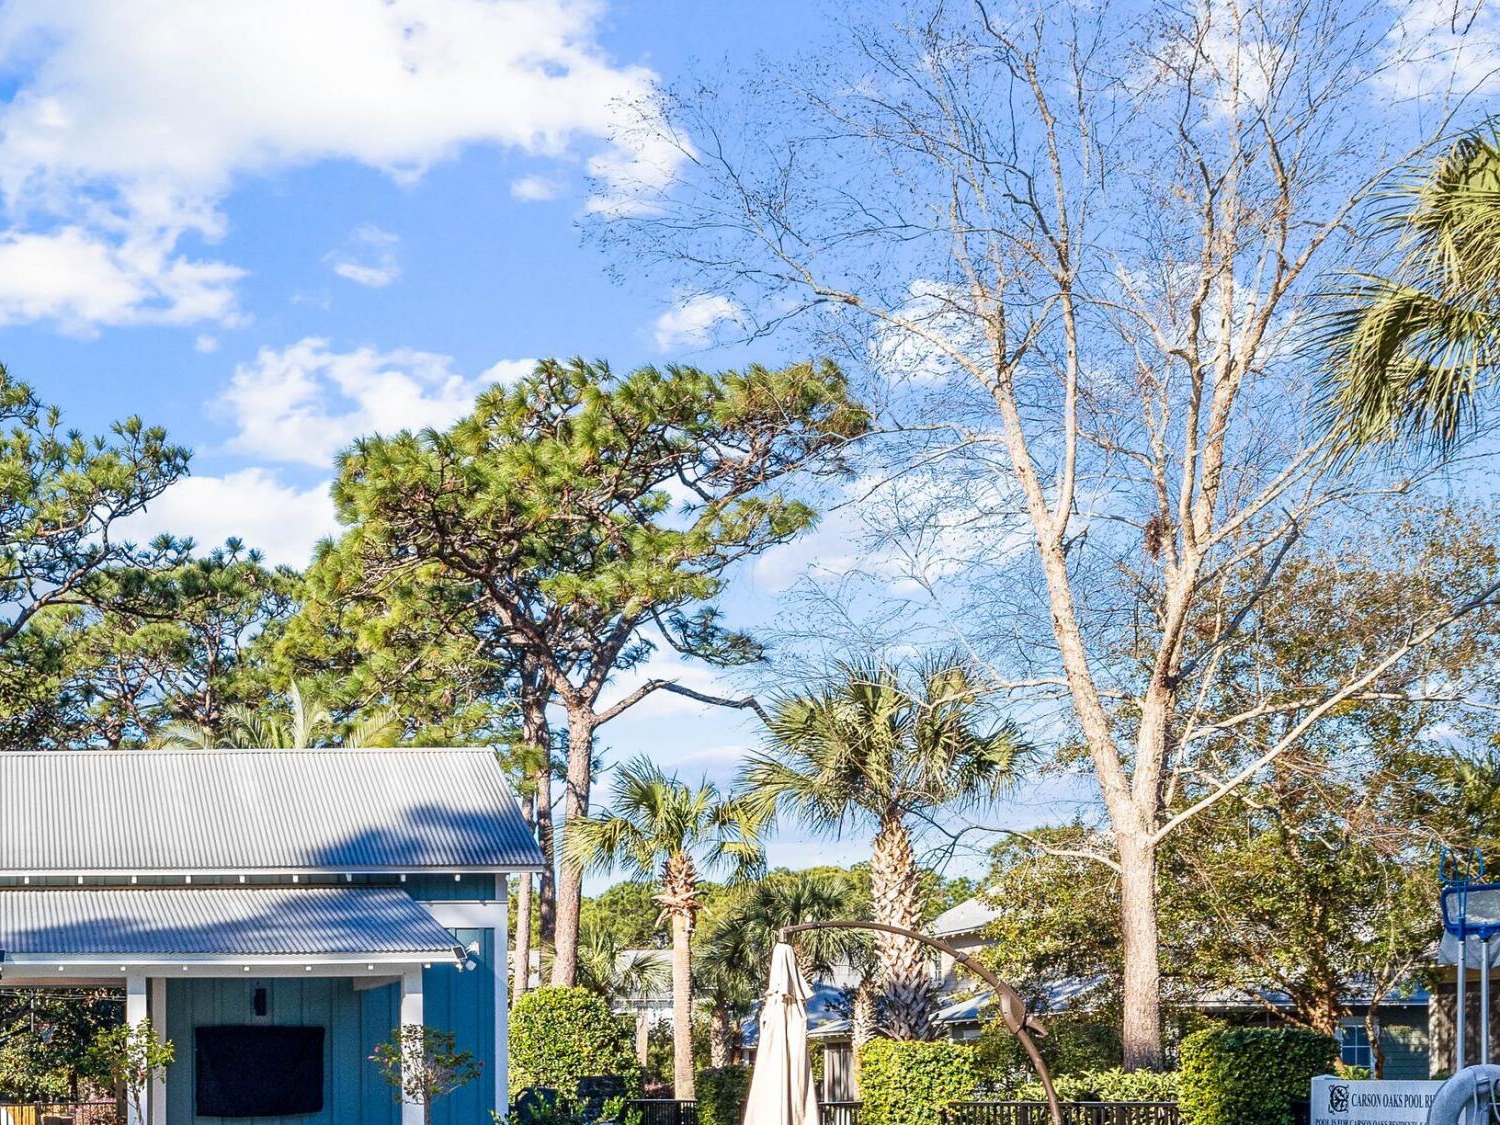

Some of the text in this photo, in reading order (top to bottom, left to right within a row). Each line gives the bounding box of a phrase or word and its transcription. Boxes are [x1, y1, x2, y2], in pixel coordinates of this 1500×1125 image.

[1351, 1093, 1381, 1107] CARSON
[1383, 1094, 1403, 1108] OAKS
[1404, 1094, 1423, 1109] POOL
